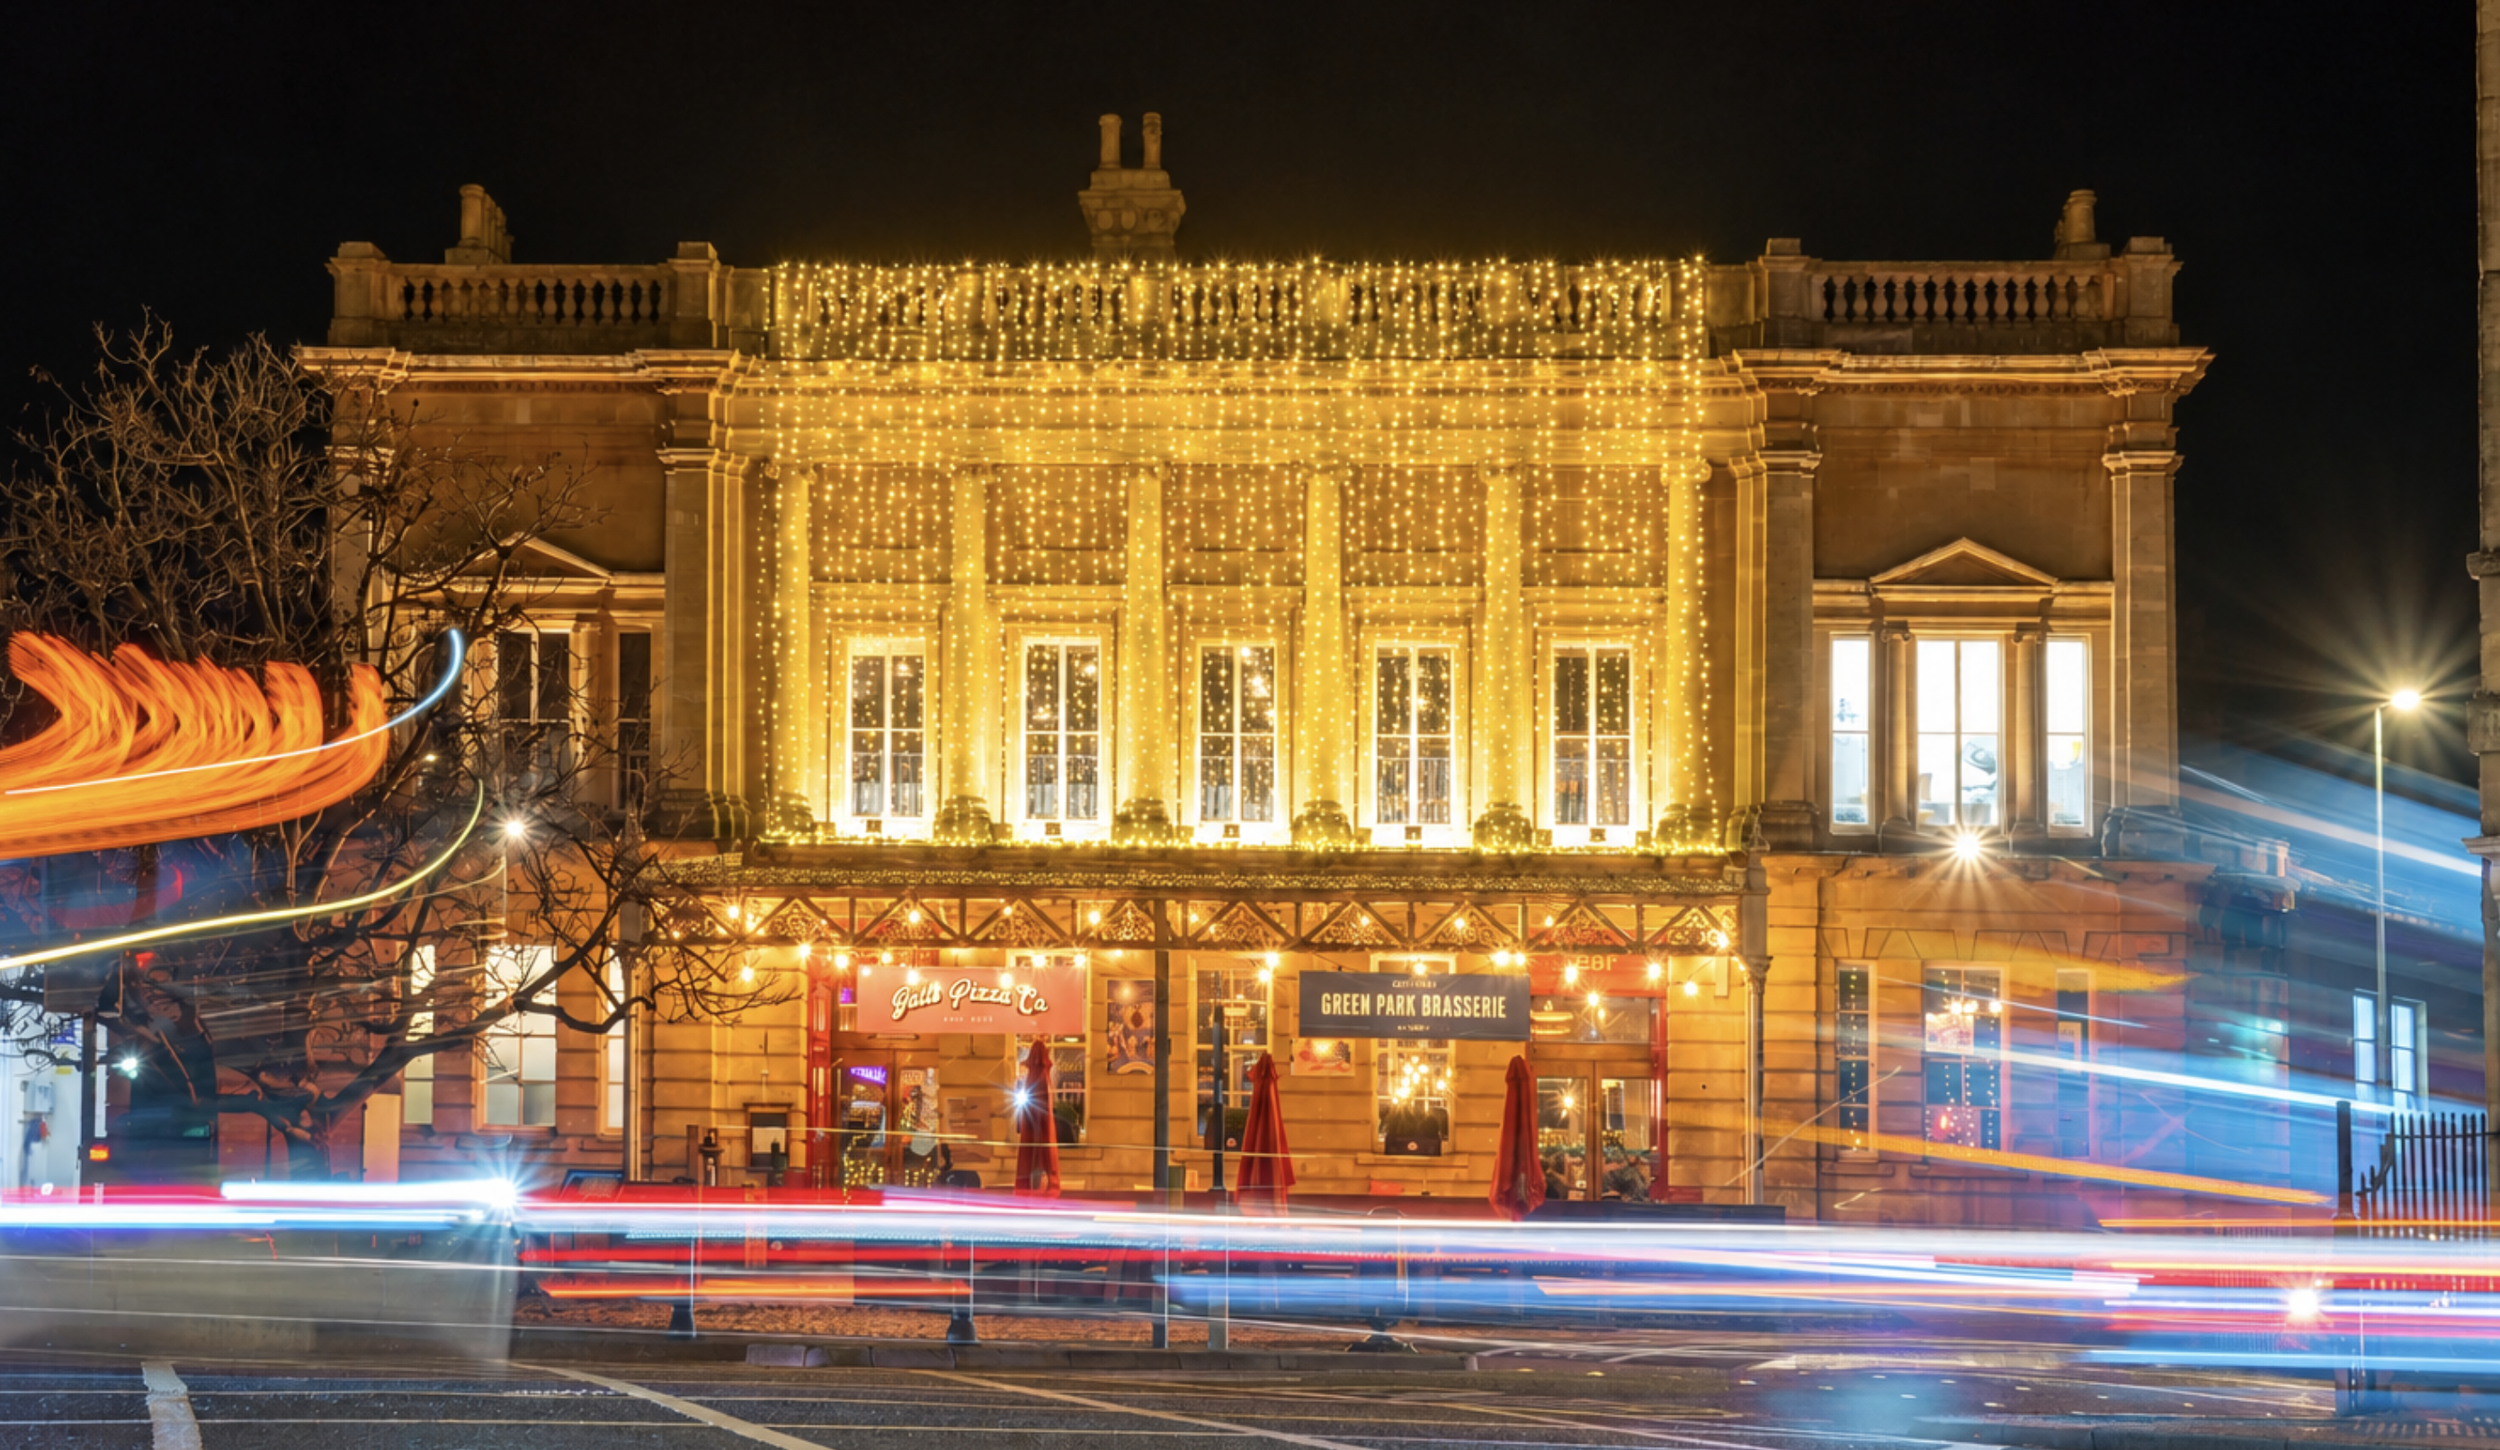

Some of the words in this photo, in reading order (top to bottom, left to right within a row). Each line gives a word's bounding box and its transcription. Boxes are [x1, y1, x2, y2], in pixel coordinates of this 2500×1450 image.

[949, 978, 1011, 1010] Pizza
[1016, 984, 1048, 1015] Co
[1321, 993, 1371, 1016] GREEN
[1377, 994, 1416, 1017] PARK
[1421, 995, 1507, 1018] BRASSERIE
